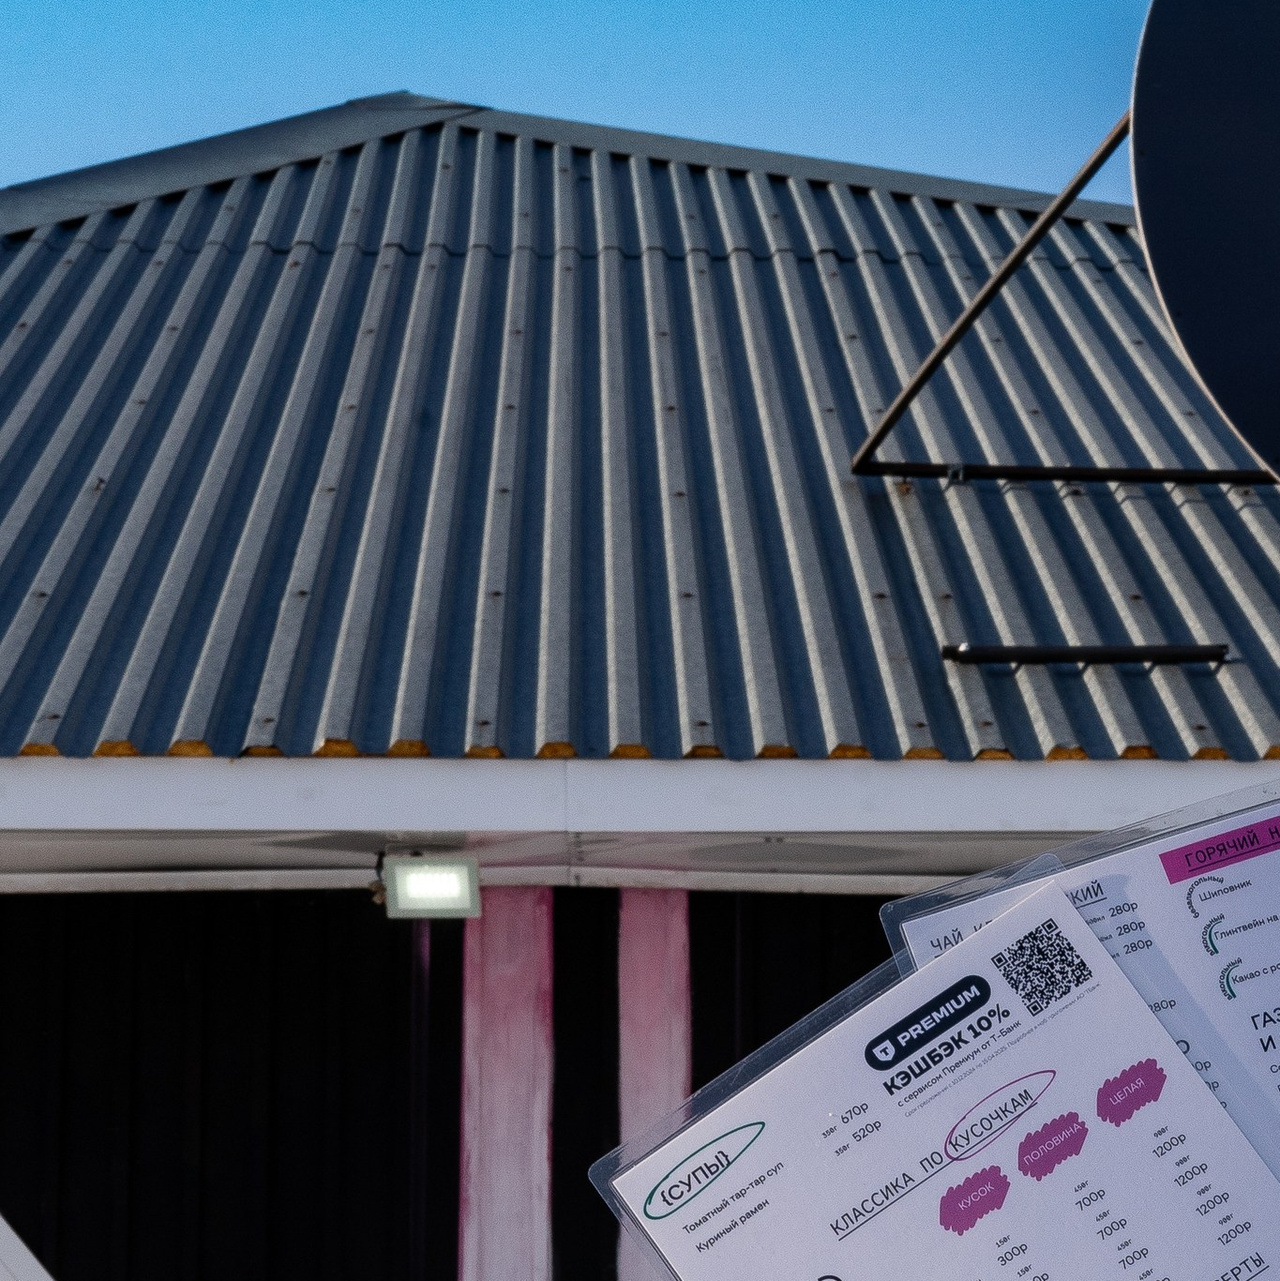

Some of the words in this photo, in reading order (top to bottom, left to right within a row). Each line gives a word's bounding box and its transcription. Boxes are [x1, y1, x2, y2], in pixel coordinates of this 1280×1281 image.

[1183, 830, 1260, 867] ГОРЯЧИЙ
[1107, 901, 1138, 918] 280р
[1197, 879, 1252, 902] Шиповник
[929, 927, 964, 950] ЧАЙ
[1115, 920, 1145, 937] 280р
[1122, 938, 1153, 955] 280р
[1213, 917, 1266, 940] Глинтвейн
[1265, 914, 1279, 923] на
[1231, 969, 1261, 985] Какао
[1261, 966, 1269, 975] с
[895, 983, 981, 1047] PREMIUM
[1258, 1034, 1277, 1053] И
[881, 1029, 970, 1096] КЭШБЭК
[964, 1000, 1012, 1040] 10%
[896, 1099, 904, 1107] с
[902, 1073, 943, 1103] сервисом
[940, 1047, 981, 1076] Премиум
[980, 1039, 991, 1050] от
[988, 1019, 1022, 1042] Т-Банк
[820, 1124, 837, 1139] 350г
[839, 1102, 869, 1124] 670р
[833, 1142, 850, 1157] 350г
[851, 1119, 882, 1142] 520р
[956, 1180, 995, 1211] КУСОК
[1022, 1120, 1083, 1166] ПОЛОВИНА
[1108, 1076, 1146, 1106] ЦЕЛАЯ
[657, 1147, 733, 1208] {СУПЫ}
[828, 1169, 916, 1237] КЛАССИКА
[918, 1149, 946, 1174] ПО
[947, 1087, 1034, 1154] КУСОЧКАМ
[994, 1234, 1010, 1248] 150г
[1073, 1179, 1088, 1193] 450г
[1152, 1125, 1168, 1138] 900г
[681, 1197, 731, 1234] Томатный
[728, 1174, 766, 1202] тар-тар
[765, 1161, 784, 1177] суп
[694, 1218, 739, 1253] Куриный
[738, 1198, 770, 1225] рамен
[996, 1242, 1028, 1266] 300р
[1074, 1188, 1106, 1211] 700р
[1151, 1133, 1186, 1158] 1200р
[1016, 1263, 1032, 1278] 150г
[1094, 1208, 1110, 1222] 450г
[1174, 1154, 1190, 1167] 900г
[1095, 1217, 1127, 1240] 700р
[1173, 1162, 1208, 1187] 1200р
[1116, 1238, 1132, 1251] 450г
[1195, 1183, 1212, 1197] 900г
[1117, 1246, 1149, 1270] 700р
[1194, 1191, 1230, 1216] 1200р
[1138, 1267, 1153, 1281] 450г
[1217, 1212, 1233, 1226] 900г
[1216, 1220, 1252, 1246] 1200р
